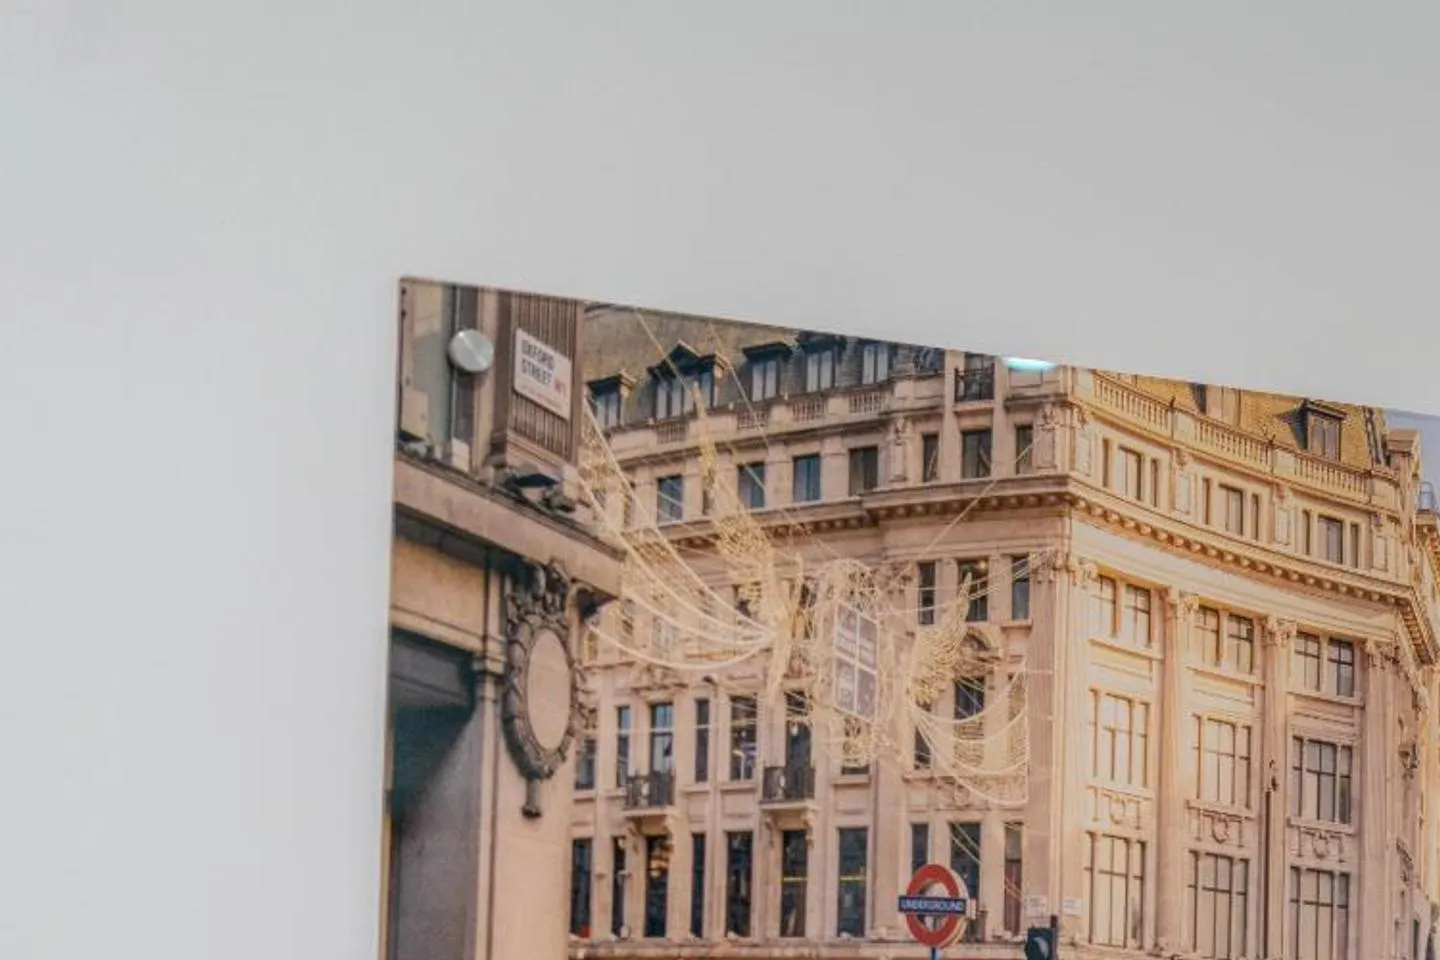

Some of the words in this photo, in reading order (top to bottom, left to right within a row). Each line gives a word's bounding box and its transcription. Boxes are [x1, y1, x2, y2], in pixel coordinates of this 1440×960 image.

[521, 339, 555, 371] OXFORD
[521, 357, 553, 385] STREET
[900, 900, 964, 912] UNDERGROUND
